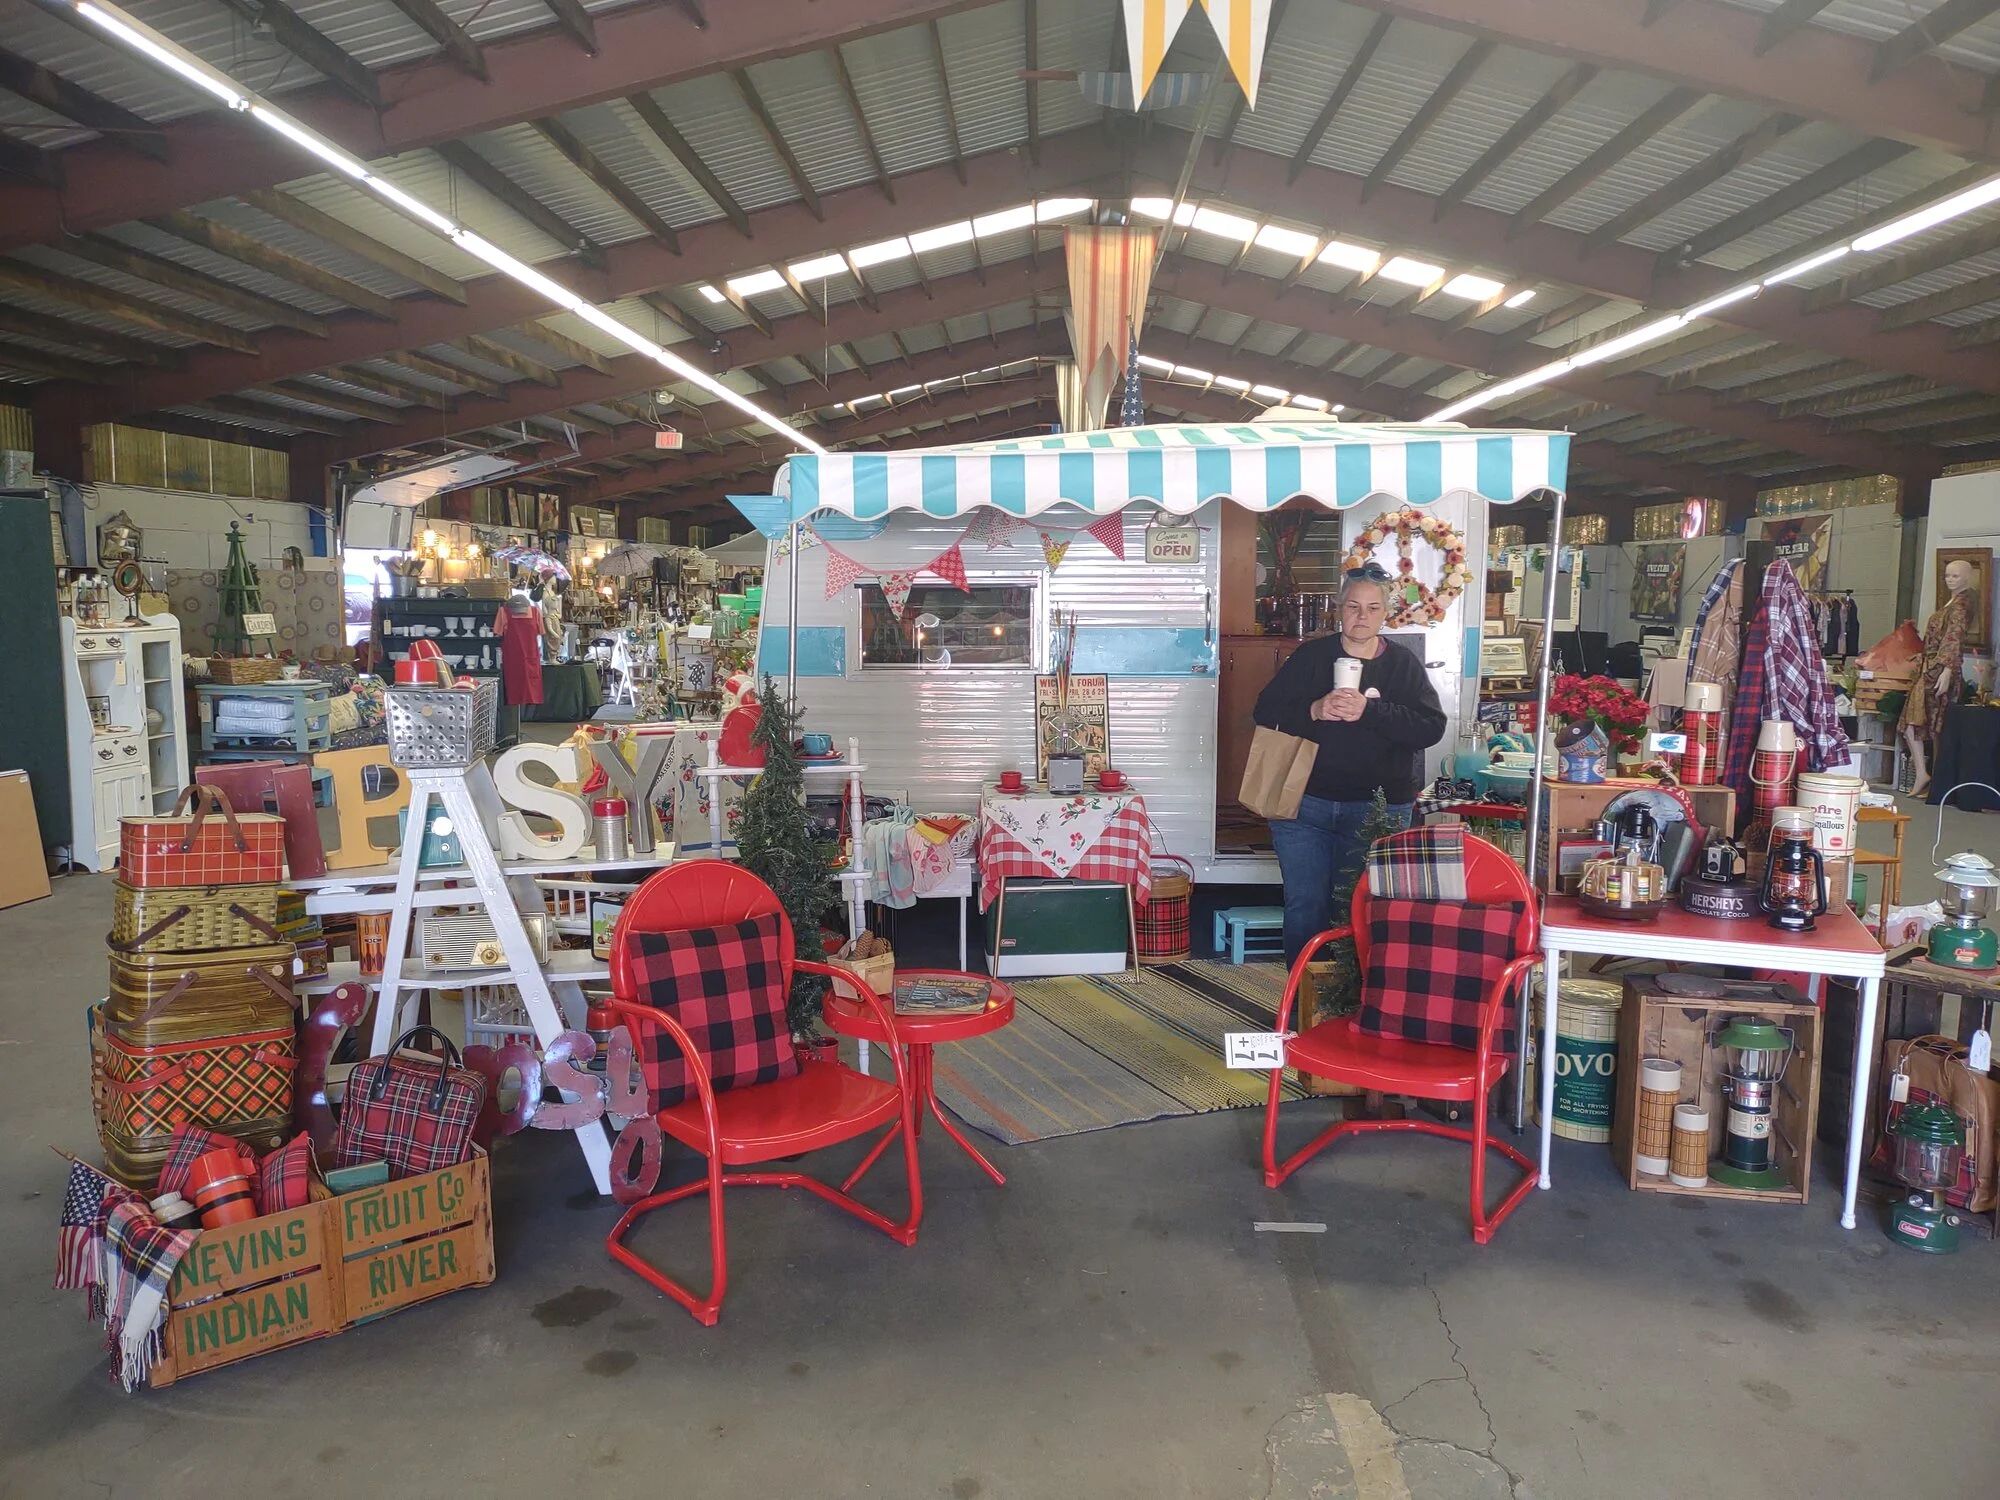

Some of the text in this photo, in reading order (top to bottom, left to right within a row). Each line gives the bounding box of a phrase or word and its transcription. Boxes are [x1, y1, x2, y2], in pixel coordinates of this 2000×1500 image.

[1153, 545, 1191, 556] OPEN
[1078, 677, 1105, 687] FORUM
[1082, 688, 1090, 696] 28
[1691, 893, 1744, 911] HERSHEY'S
[1559, 1097, 1571, 1105] FOR
[1572, 1107, 1609, 1116] SHORTENING
[344, 1184, 428, 1242] FRUIT
[174, 1219, 307, 1298] NEVINS
[369, 1239, 458, 1299] RIVER
[184, 1283, 309, 1357] INDIAN
